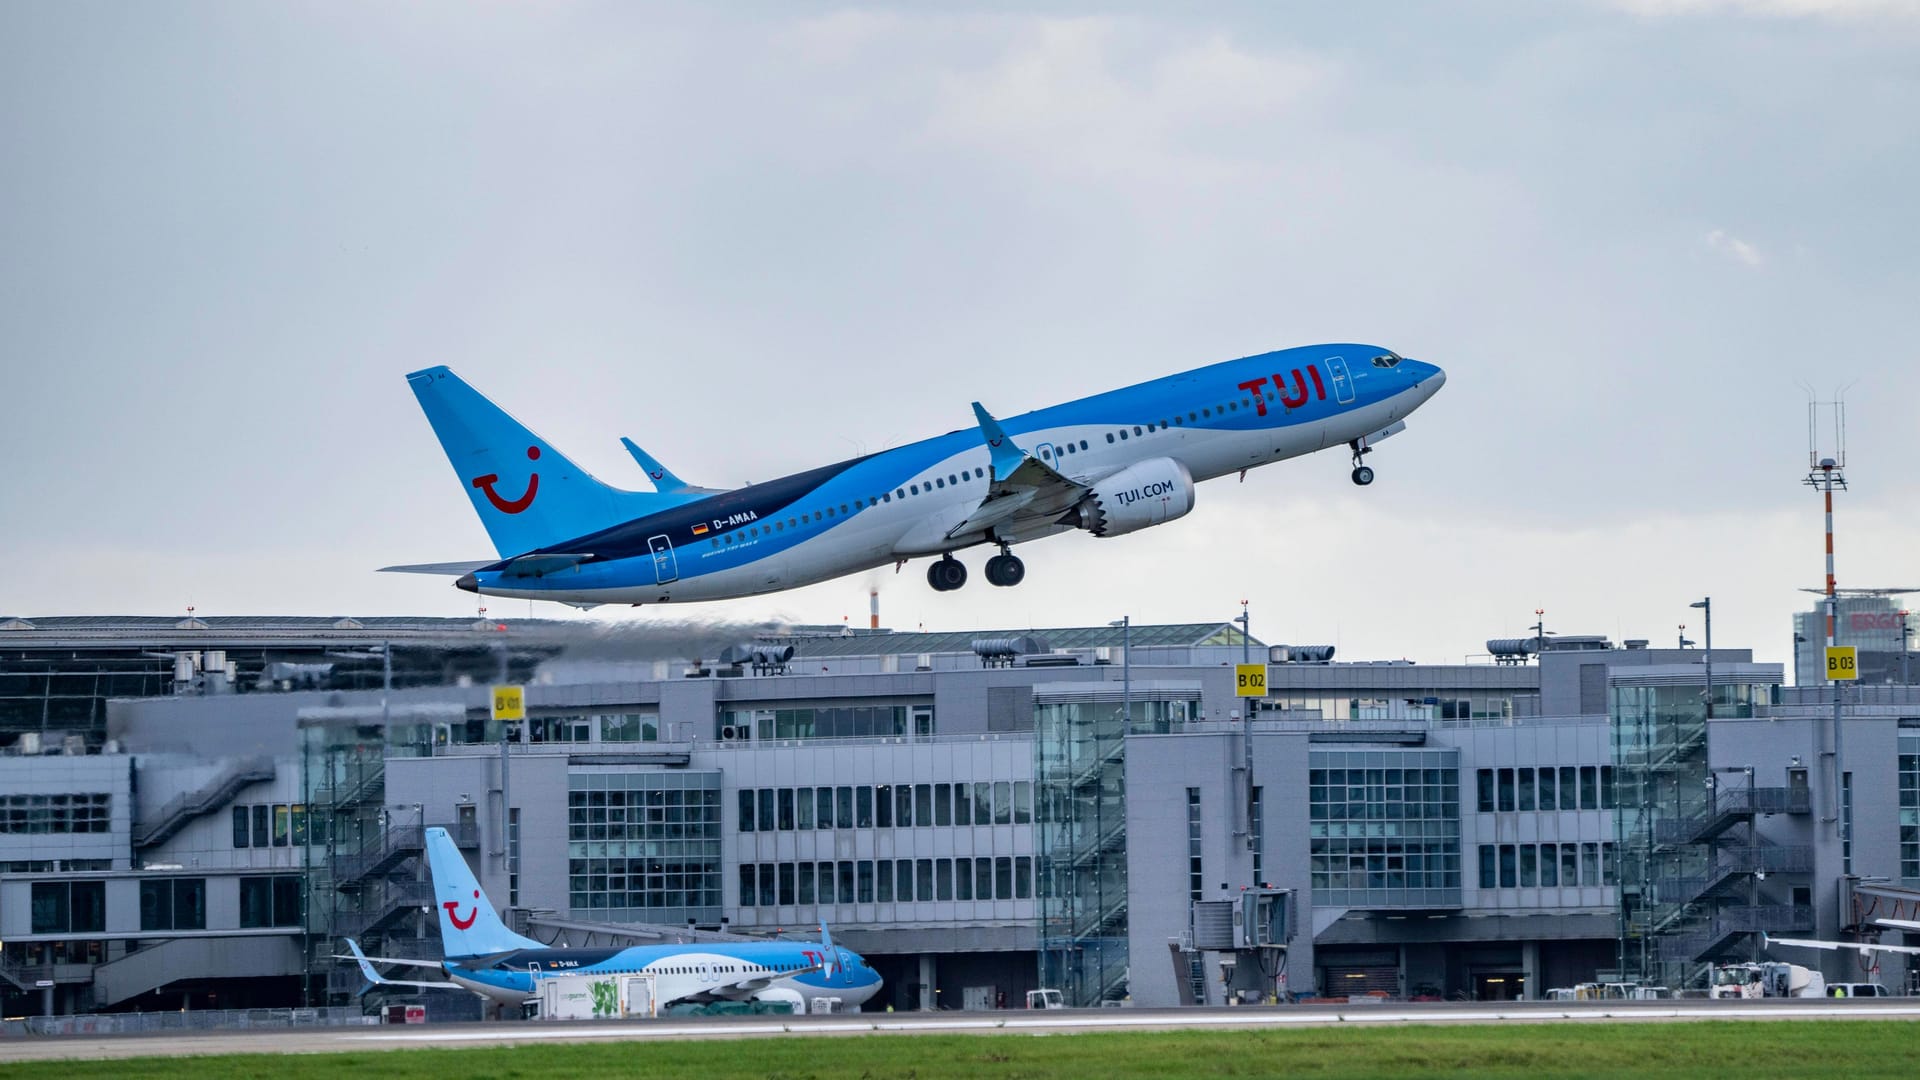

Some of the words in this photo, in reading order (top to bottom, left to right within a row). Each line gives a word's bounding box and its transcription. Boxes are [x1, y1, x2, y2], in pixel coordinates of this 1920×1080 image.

[1238, 364, 1327, 416] TUI
[1114, 479, 1174, 504] TUI.COM
[712, 510, 758, 529] D-AMAA
[1851, 612, 1904, 631] ERGO
[1828, 656, 1838, 670] B
[1840, 656, 1854, 670] 03
[1238, 674, 1247, 687] B
[1250, 674, 1264, 687] 02
